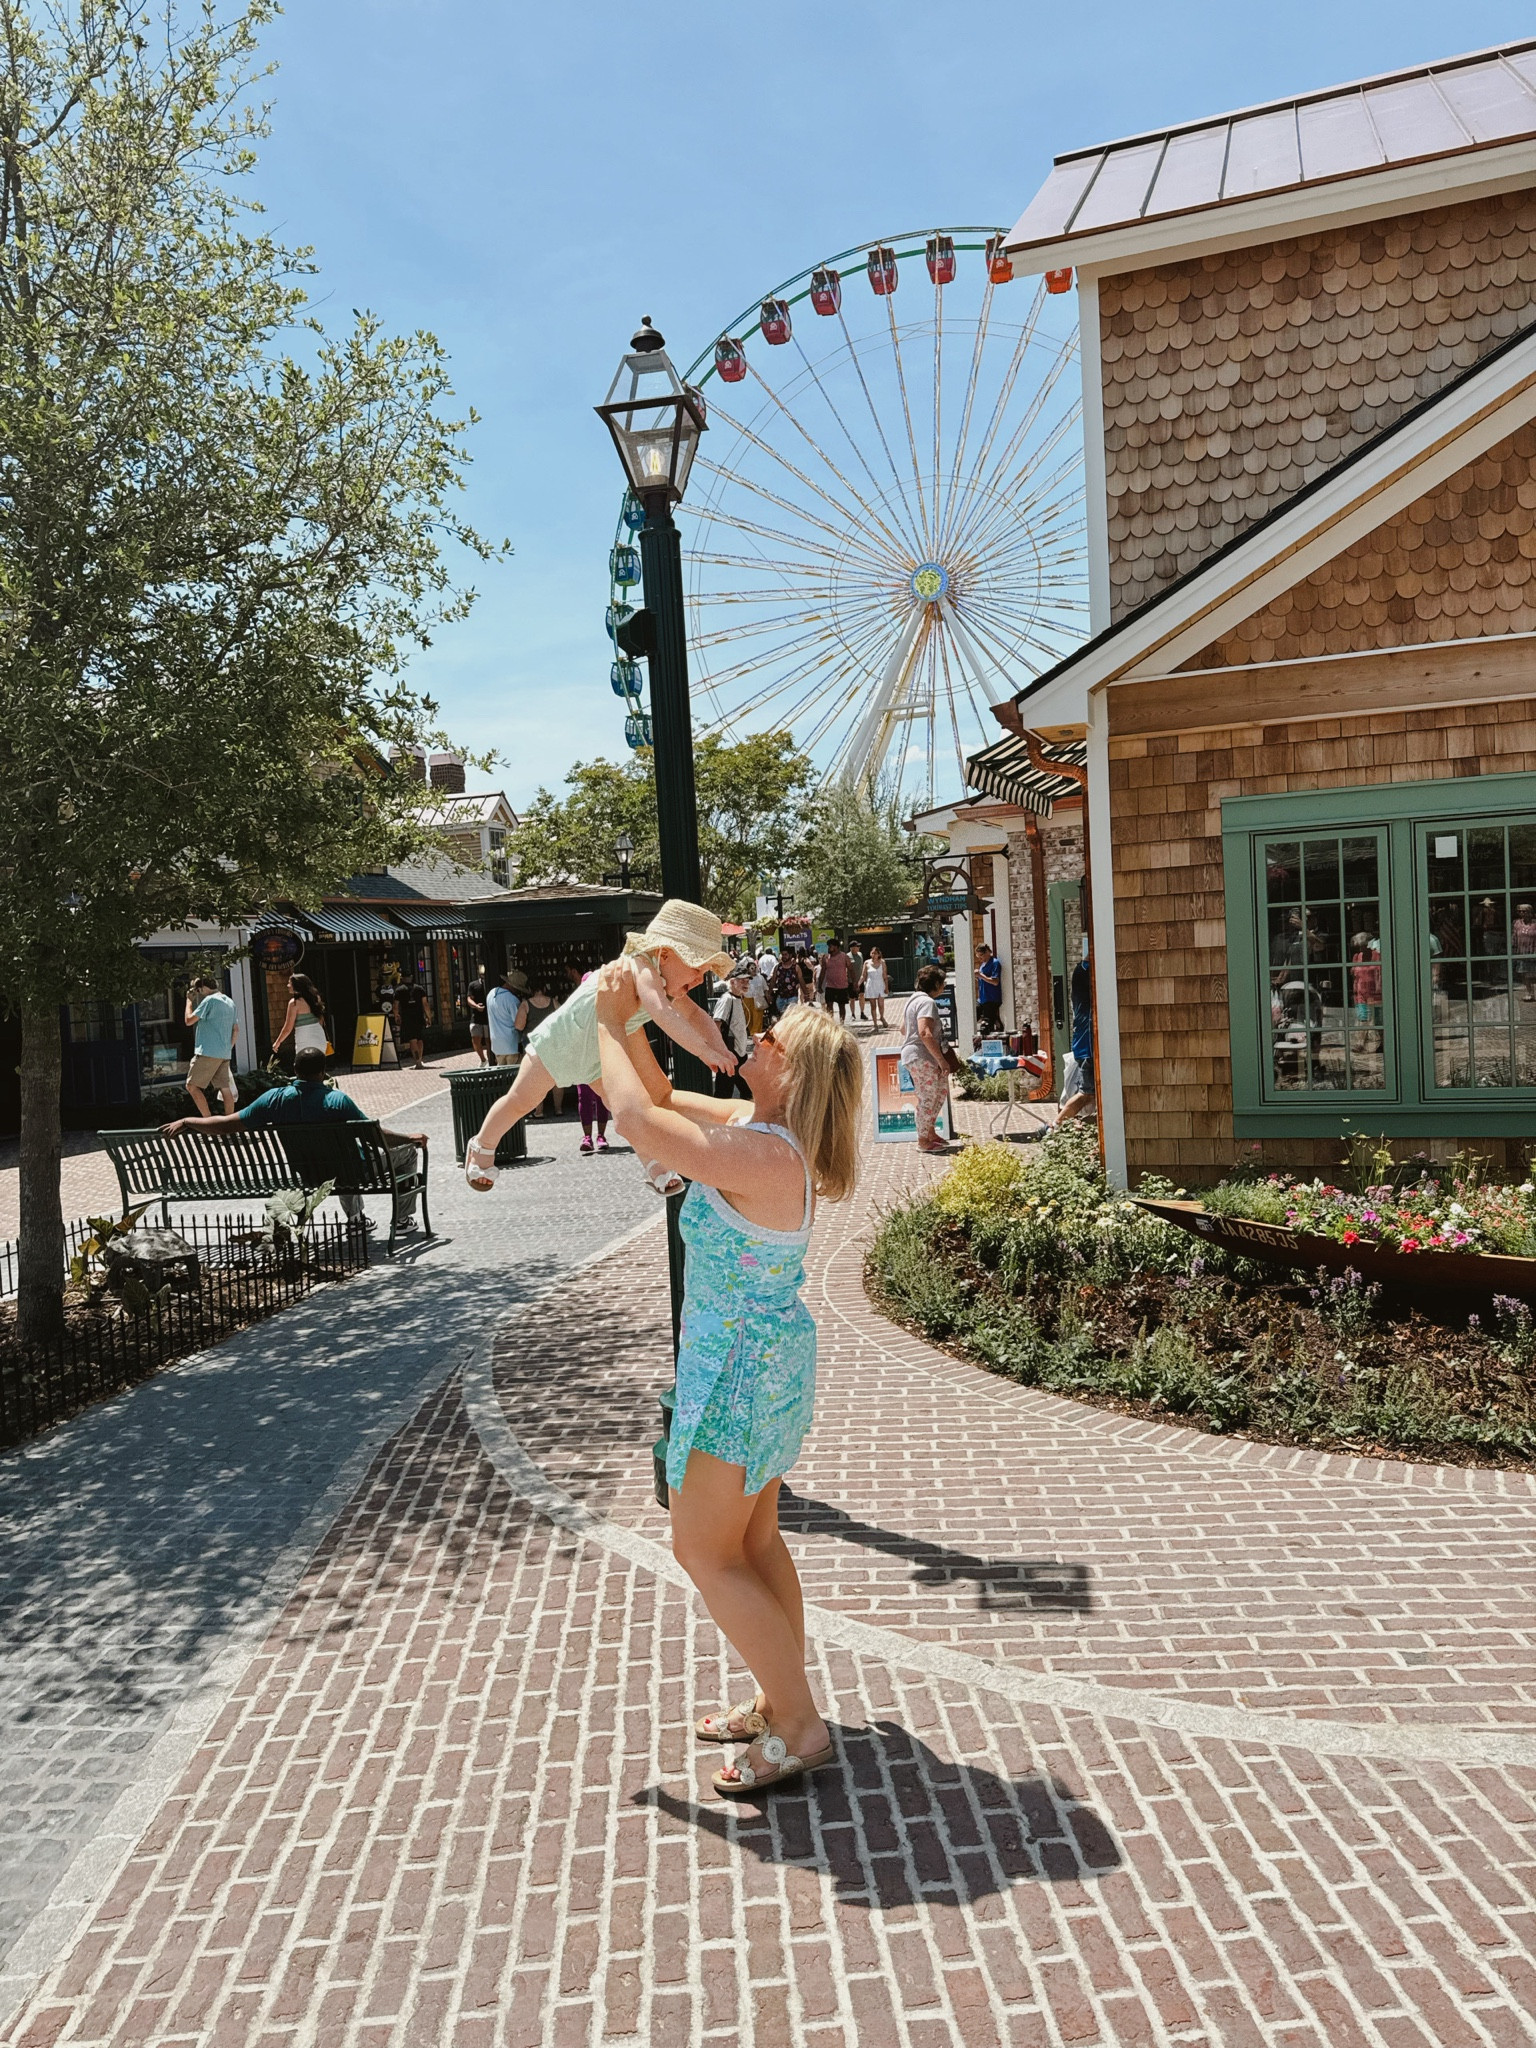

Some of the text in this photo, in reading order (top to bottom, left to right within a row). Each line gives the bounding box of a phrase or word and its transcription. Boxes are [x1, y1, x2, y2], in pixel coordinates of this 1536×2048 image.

[927, 895, 966, 904] WYNDHAM
[927, 902, 968, 911] TOURIST TIPS
